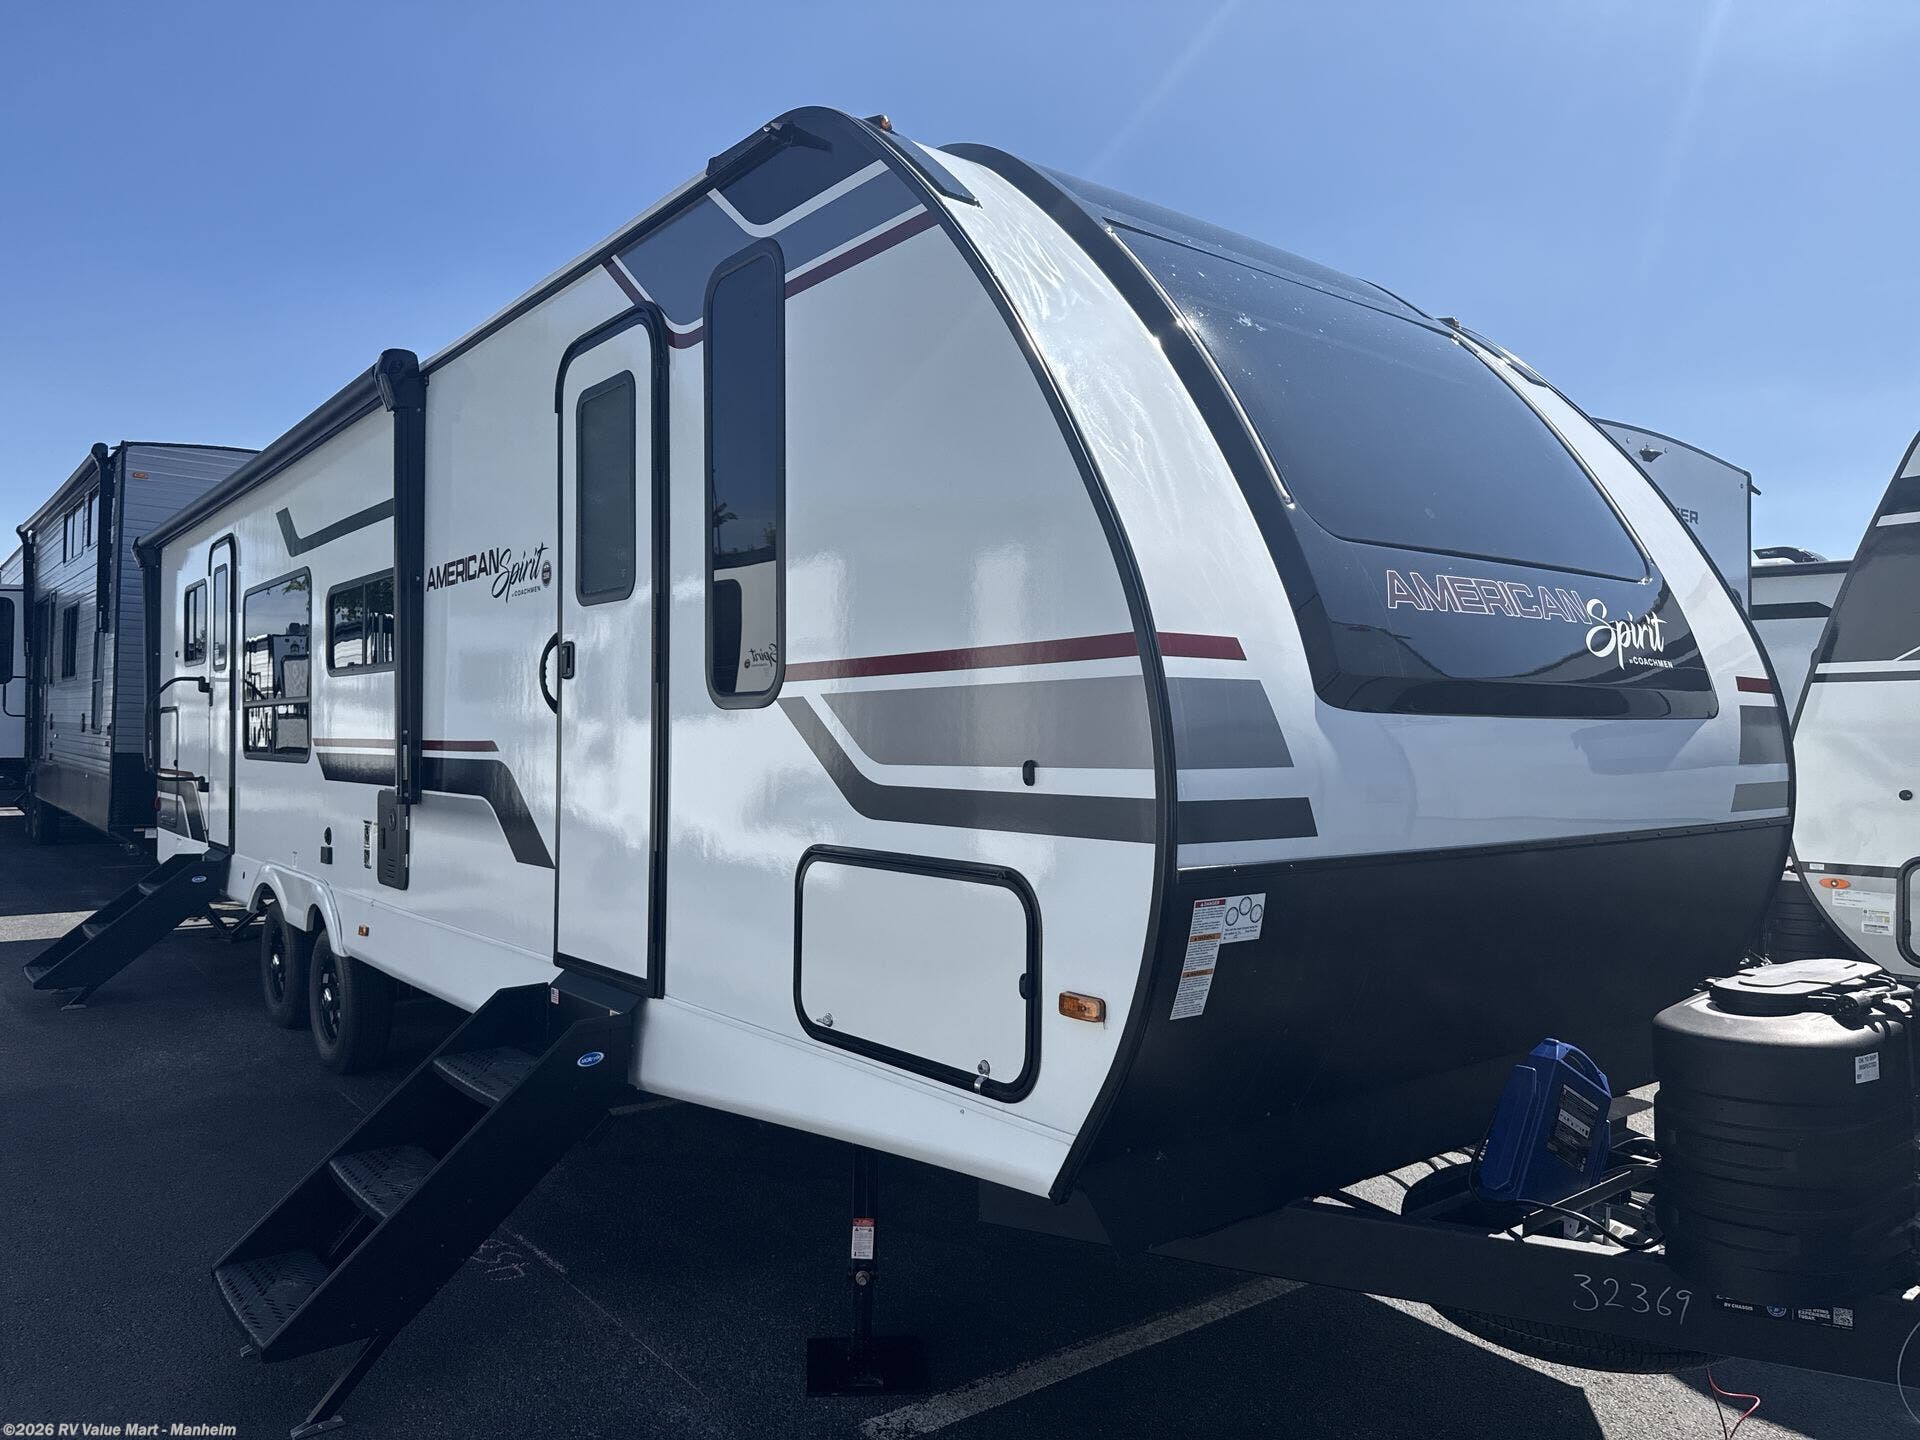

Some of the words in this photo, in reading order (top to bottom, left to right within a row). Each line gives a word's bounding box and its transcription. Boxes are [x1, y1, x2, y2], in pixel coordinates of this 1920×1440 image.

[1677, 507, 1699, 525] ER
[426, 547, 500, 592] AMERICAN
[491, 541, 549, 604] Spirit
[1386, 569, 1593, 625] AMERICAN
[1585, 598, 1668, 671] Spirit
[1632, 656, 1674, 669] COACHMEN
[1573, 1273, 1694, 1326] 32369
